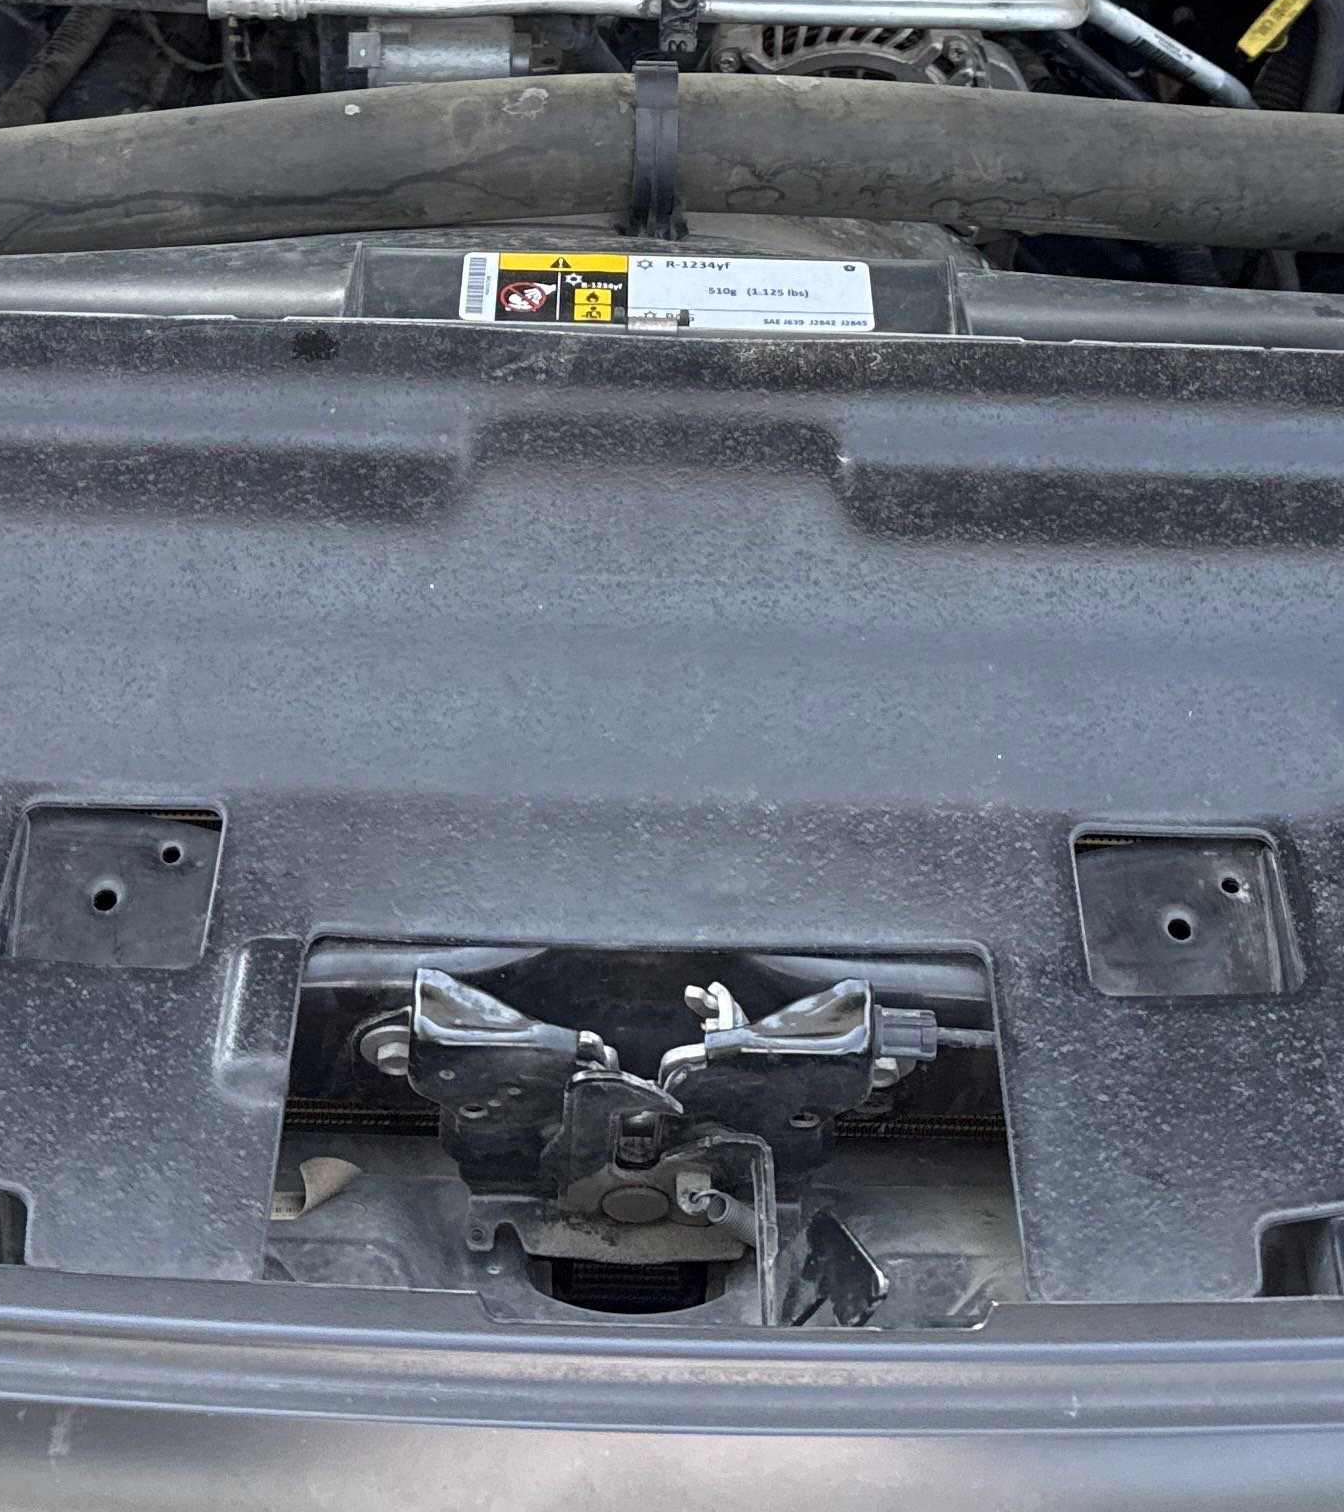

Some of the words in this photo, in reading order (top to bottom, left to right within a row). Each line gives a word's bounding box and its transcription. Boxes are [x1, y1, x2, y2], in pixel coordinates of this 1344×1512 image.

[665, 260, 731, 271] R-1234yf
[708, 287, 737, 297] 510g
[787, 288, 809, 299] lbs)
[763, 318, 781, 326] SAE
